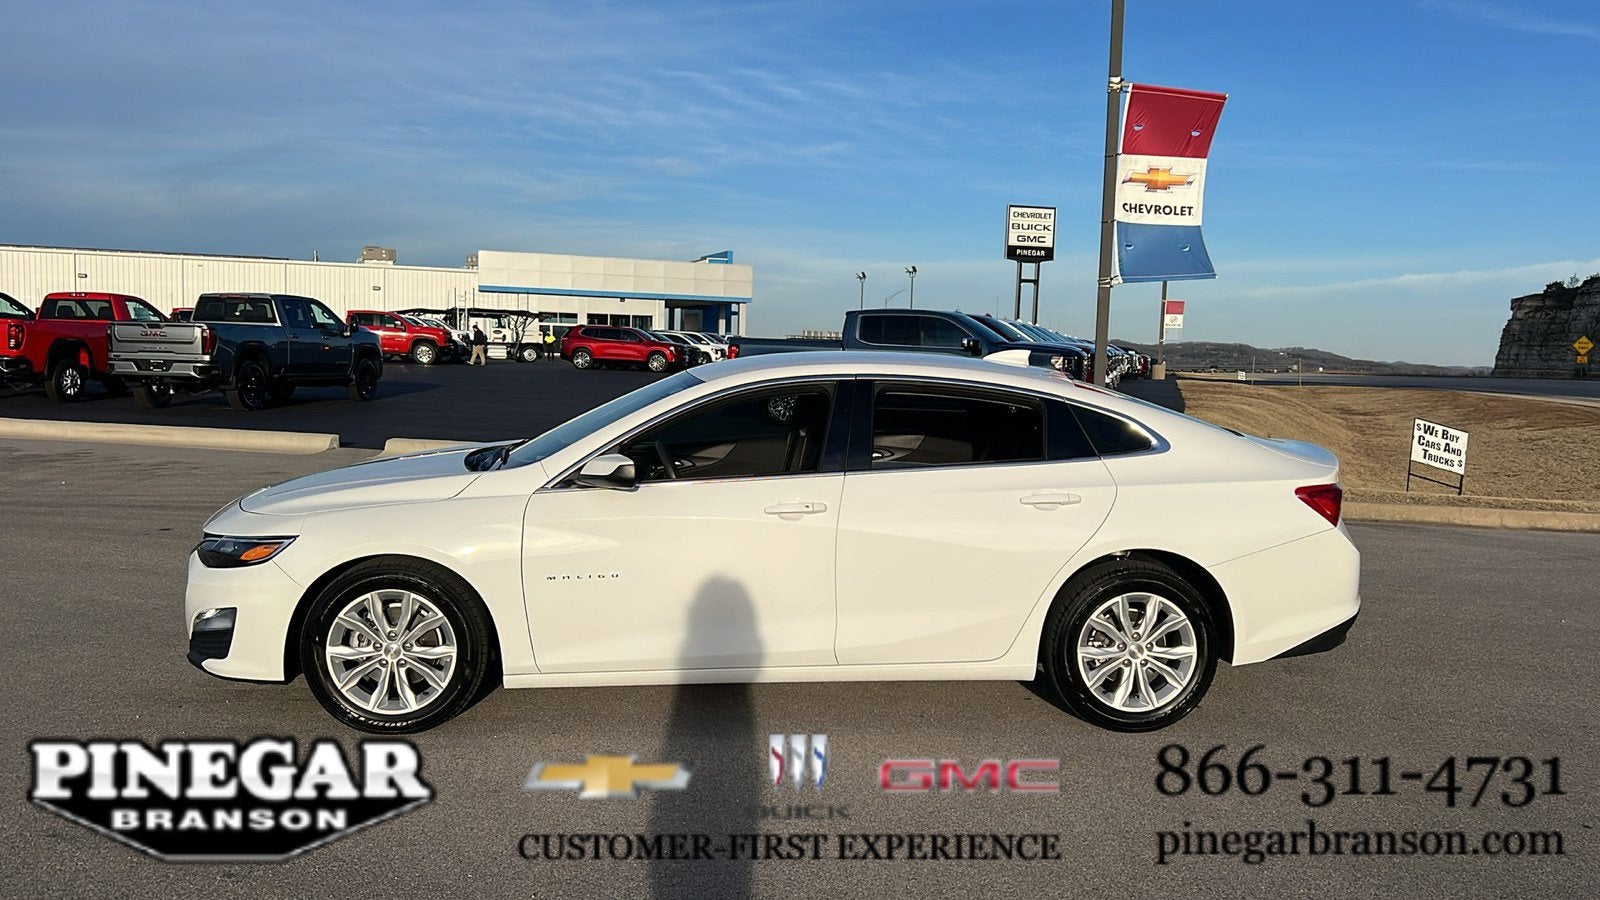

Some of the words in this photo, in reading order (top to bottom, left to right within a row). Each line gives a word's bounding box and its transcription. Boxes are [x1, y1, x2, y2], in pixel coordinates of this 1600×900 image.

[1122, 202, 1193, 216] CHEVROLET
[1013, 211, 1052, 219] CHEVROLET
[1011, 222, 1051, 231] BUICK
[1016, 235, 1046, 243] GMC
[140, 330, 167, 338] GMC
